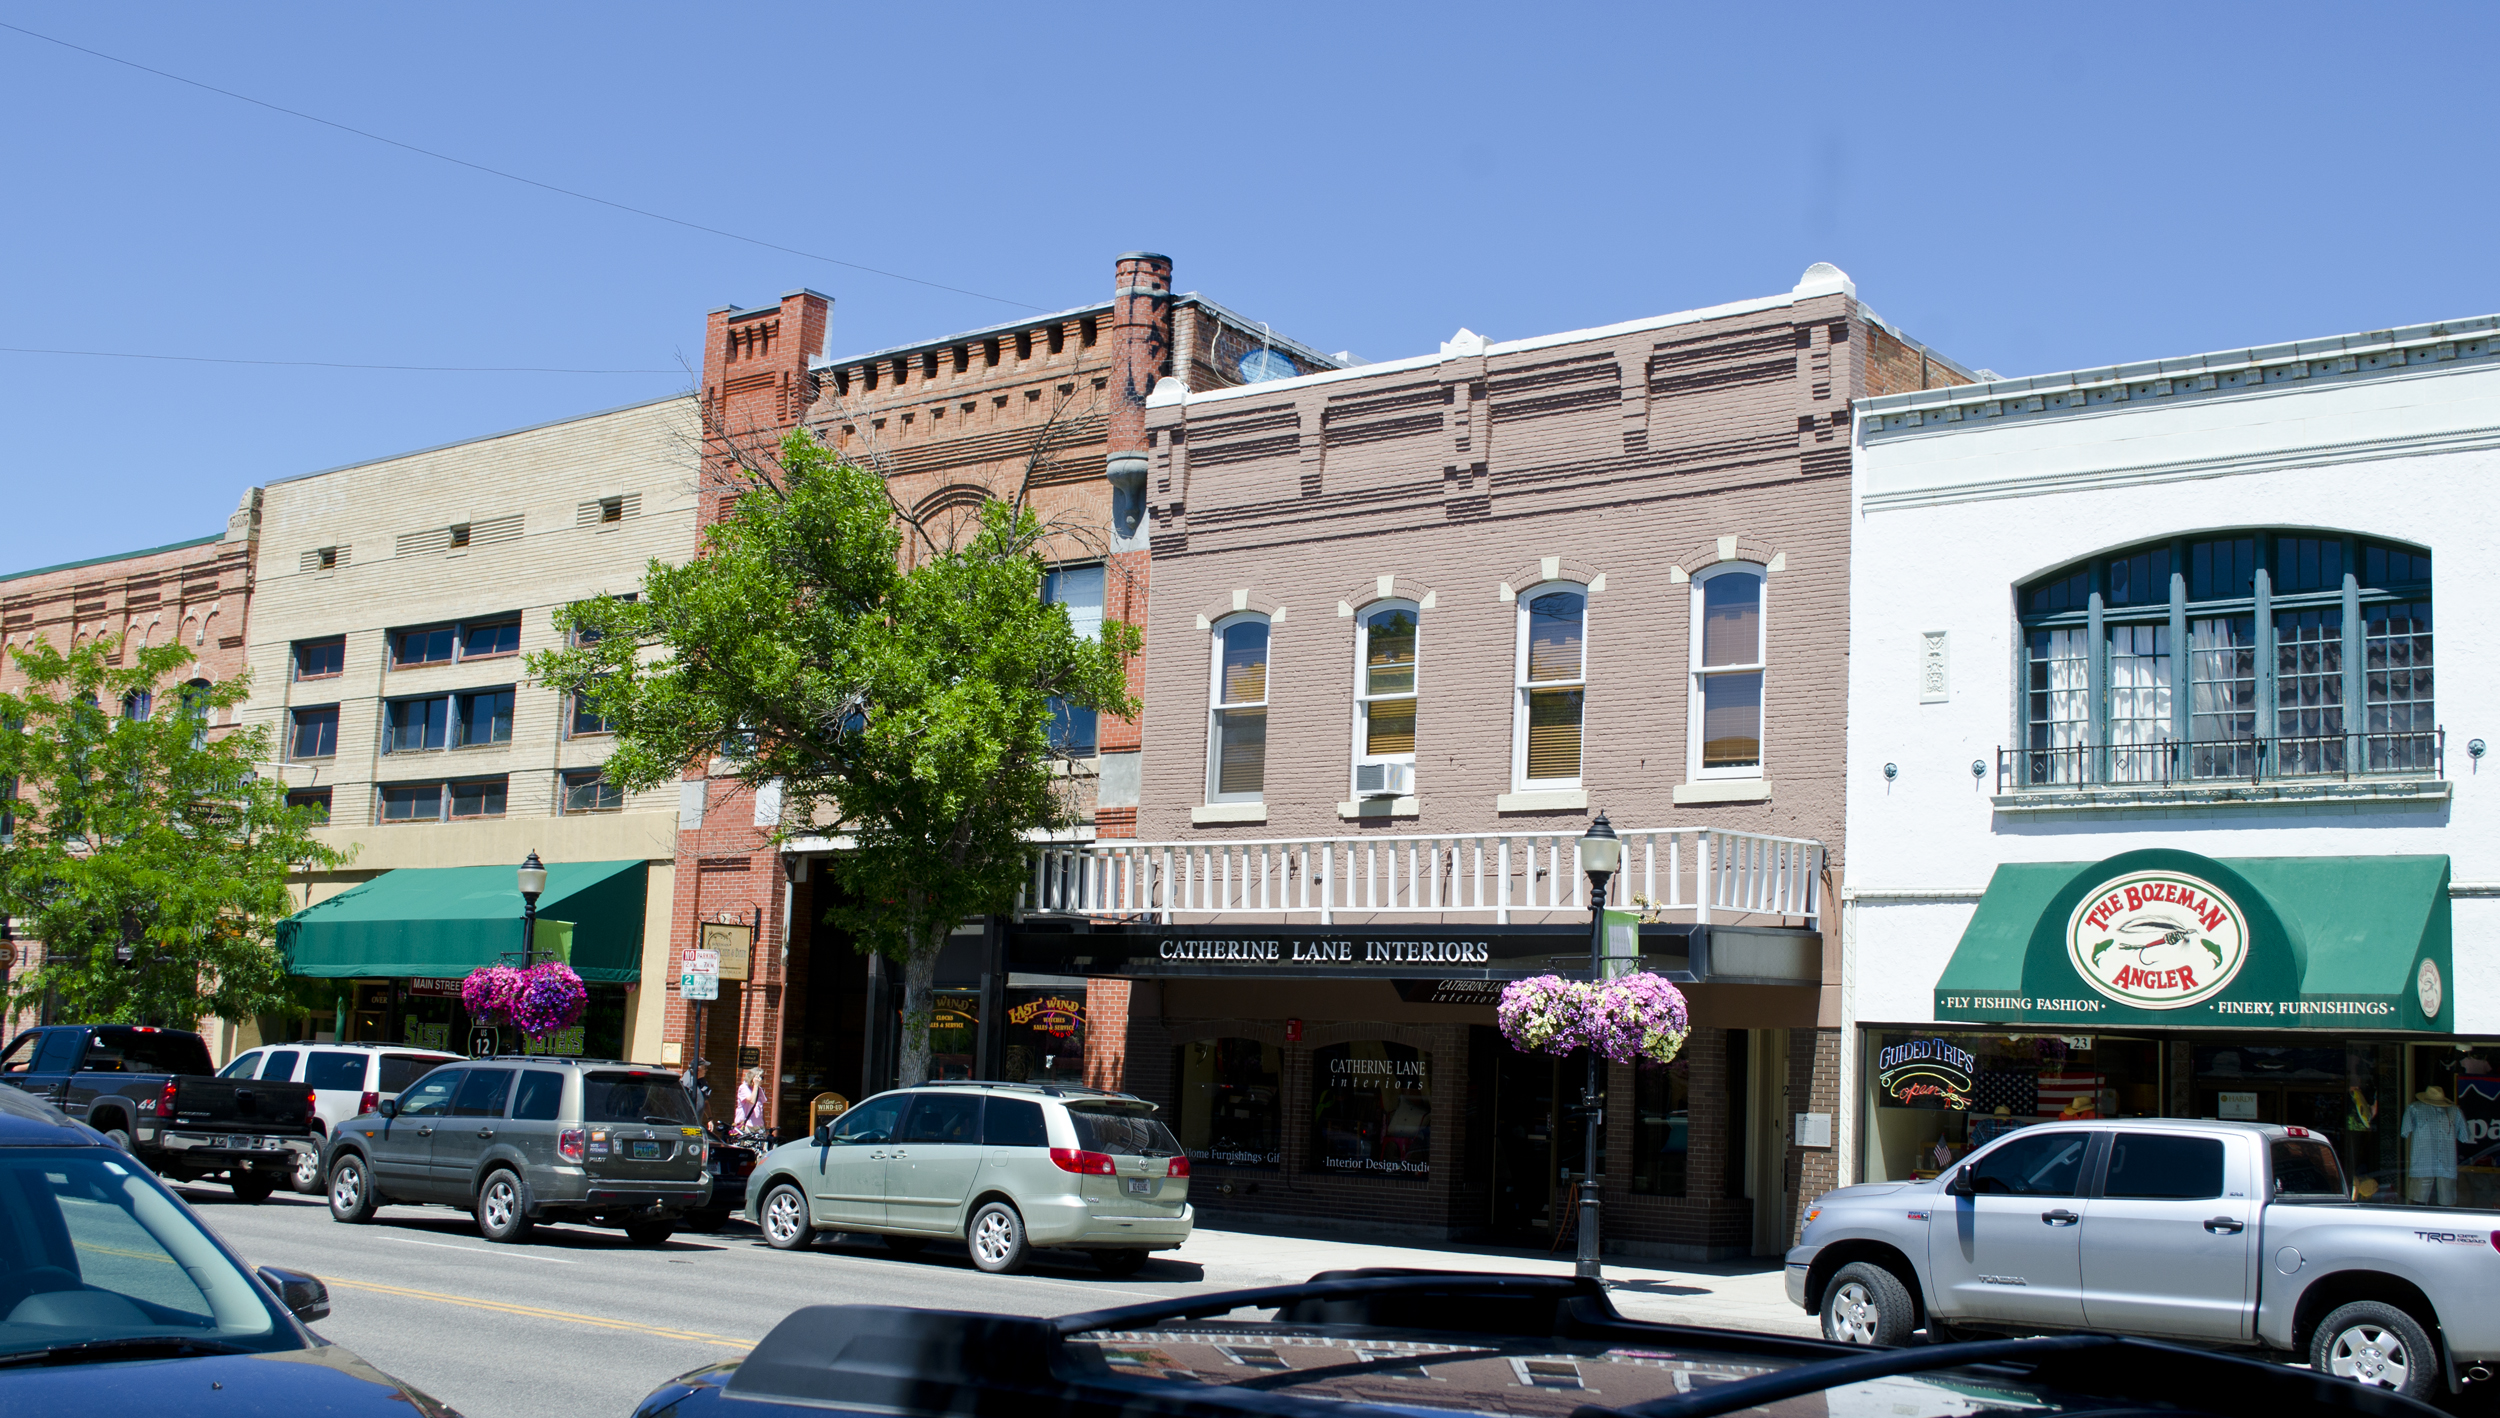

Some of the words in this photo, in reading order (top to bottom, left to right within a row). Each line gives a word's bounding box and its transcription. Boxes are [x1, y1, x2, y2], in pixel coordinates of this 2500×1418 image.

[2085, 893, 2124, 932] THE
[2124, 883, 2227, 932] BOZEMAN
[685, 950, 695, 960] NO
[697, 952, 717, 960] PARKING
[1160, 940, 1279, 960] CATHERINE
[1292, 941, 1351, 961] LANE
[1365, 941, 1488, 962] INTERIORS
[413, 978, 434, 989] MAIN
[435, 980, 465, 991] STREET
[684, 976, 692, 985] 2
[2112, 964, 2199, 991] ANGLER
[1438, 980, 1488, 992] CATHERINE
[936, 995, 969, 1011] WIND
[1008, 997, 1043, 1024] LAST
[1046, 997, 1079, 1012] WIND
[1947, 997, 1970, 1009] FLY
[1974, 997, 2032, 1010] FISHING
[2036, 998, 2099, 1012] FASHION
[2218, 1001, 2274, 1016] FINERY,
[2279, 1002, 2388, 1015] FURNISHINGS
[404, 1015, 450, 1050] SASSY
[476, 1038, 490, 1054] 12
[2073, 1037, 2088, 1049] 23
[1879, 1041, 1931, 1069] GUIDED
[1933, 1038, 1974, 1073] TRIPS
[1330, 1059, 1393, 1074] CATHERINE
[1396, 1061, 1425, 1076] LANE
[1331, 1075, 1424, 1090] interiors
[1900, 1082, 1941, 1104] open
[2228, 1095, 2254, 1103] HARDY
[1185, 1147, 1209, 1159] Home
[1211, 1149, 1262, 1164] Furnishings
[1267, 1151, 1280, 1163] Gif
[1326, 1156, 1363, 1168] Interior
[1365, 1158, 1398, 1172] Design
[2414, 1231, 2456, 1244] TRD
[1978, 1274, 2027, 1286] TUNDRA
